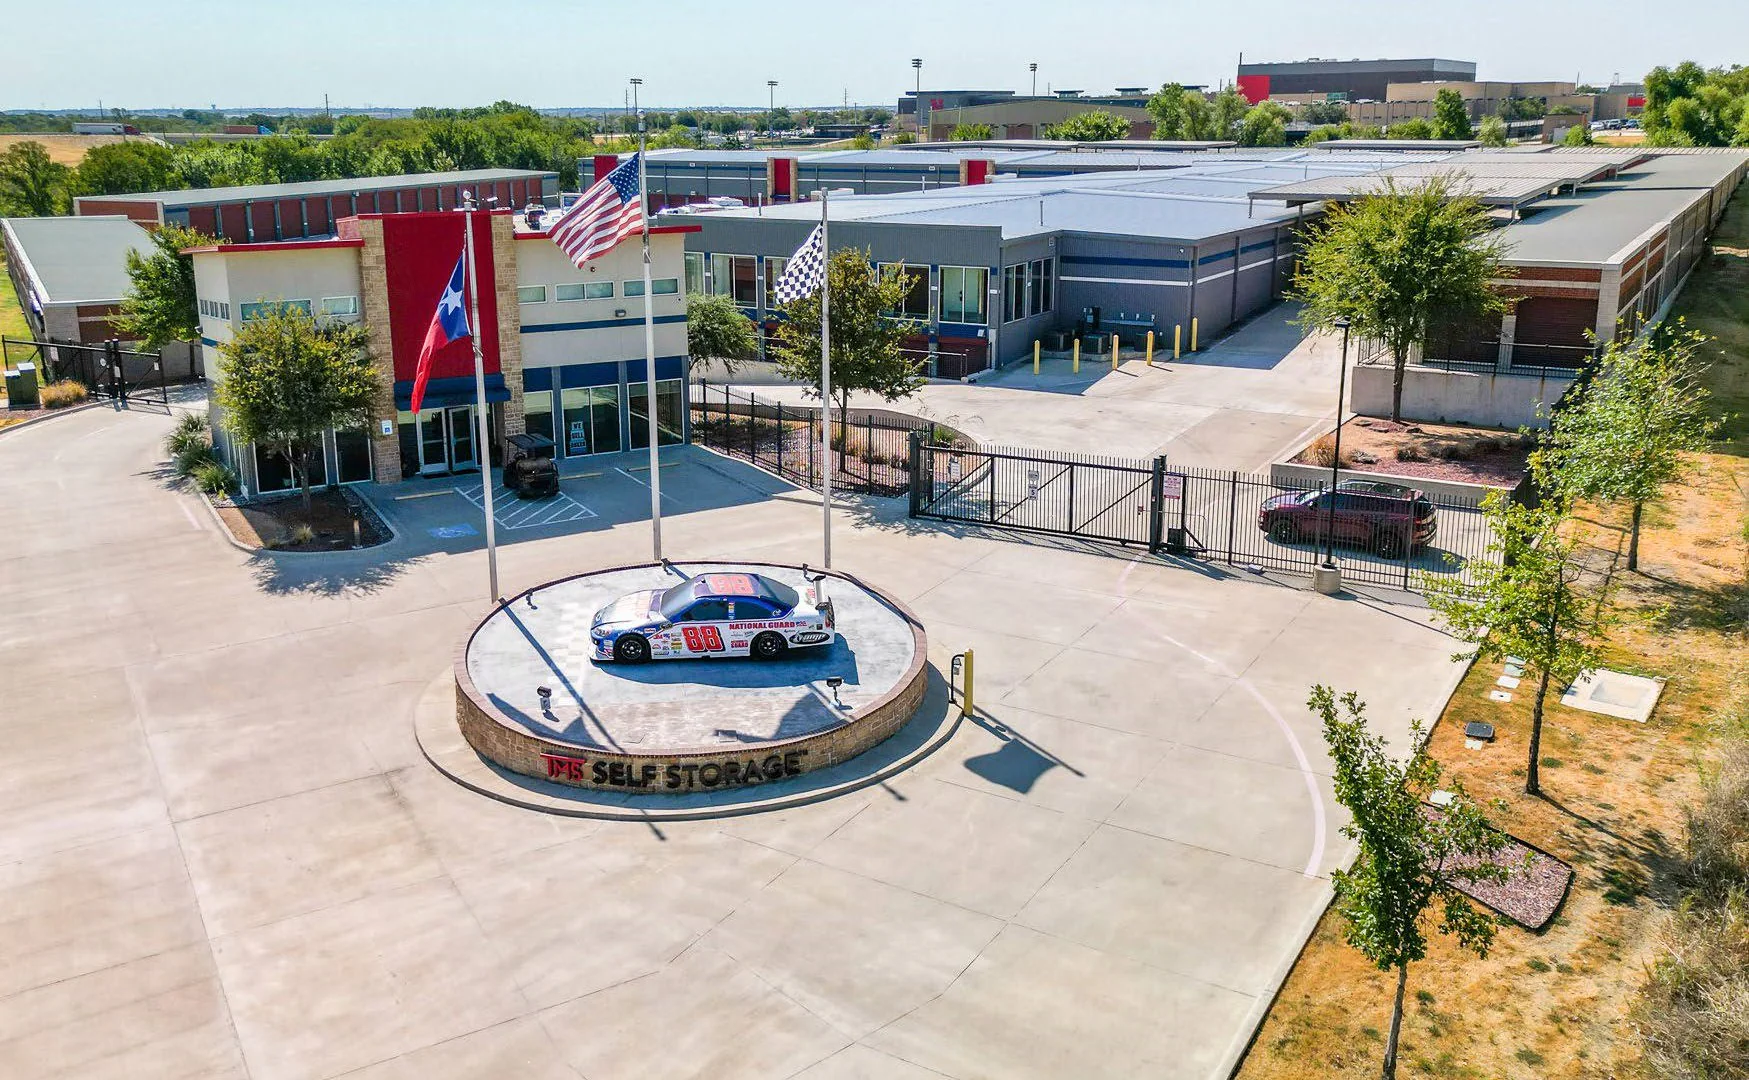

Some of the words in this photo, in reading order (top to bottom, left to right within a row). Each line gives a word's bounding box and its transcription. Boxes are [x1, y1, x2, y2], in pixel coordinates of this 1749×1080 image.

[708, 574, 754, 595] 88
[729, 622, 767, 630] NATIONAL
[768, 621, 796, 629] GUARD
[682, 625, 724, 653] 88
[539, 752, 586, 782] TMS
[591, 760, 657, 788] SELF
